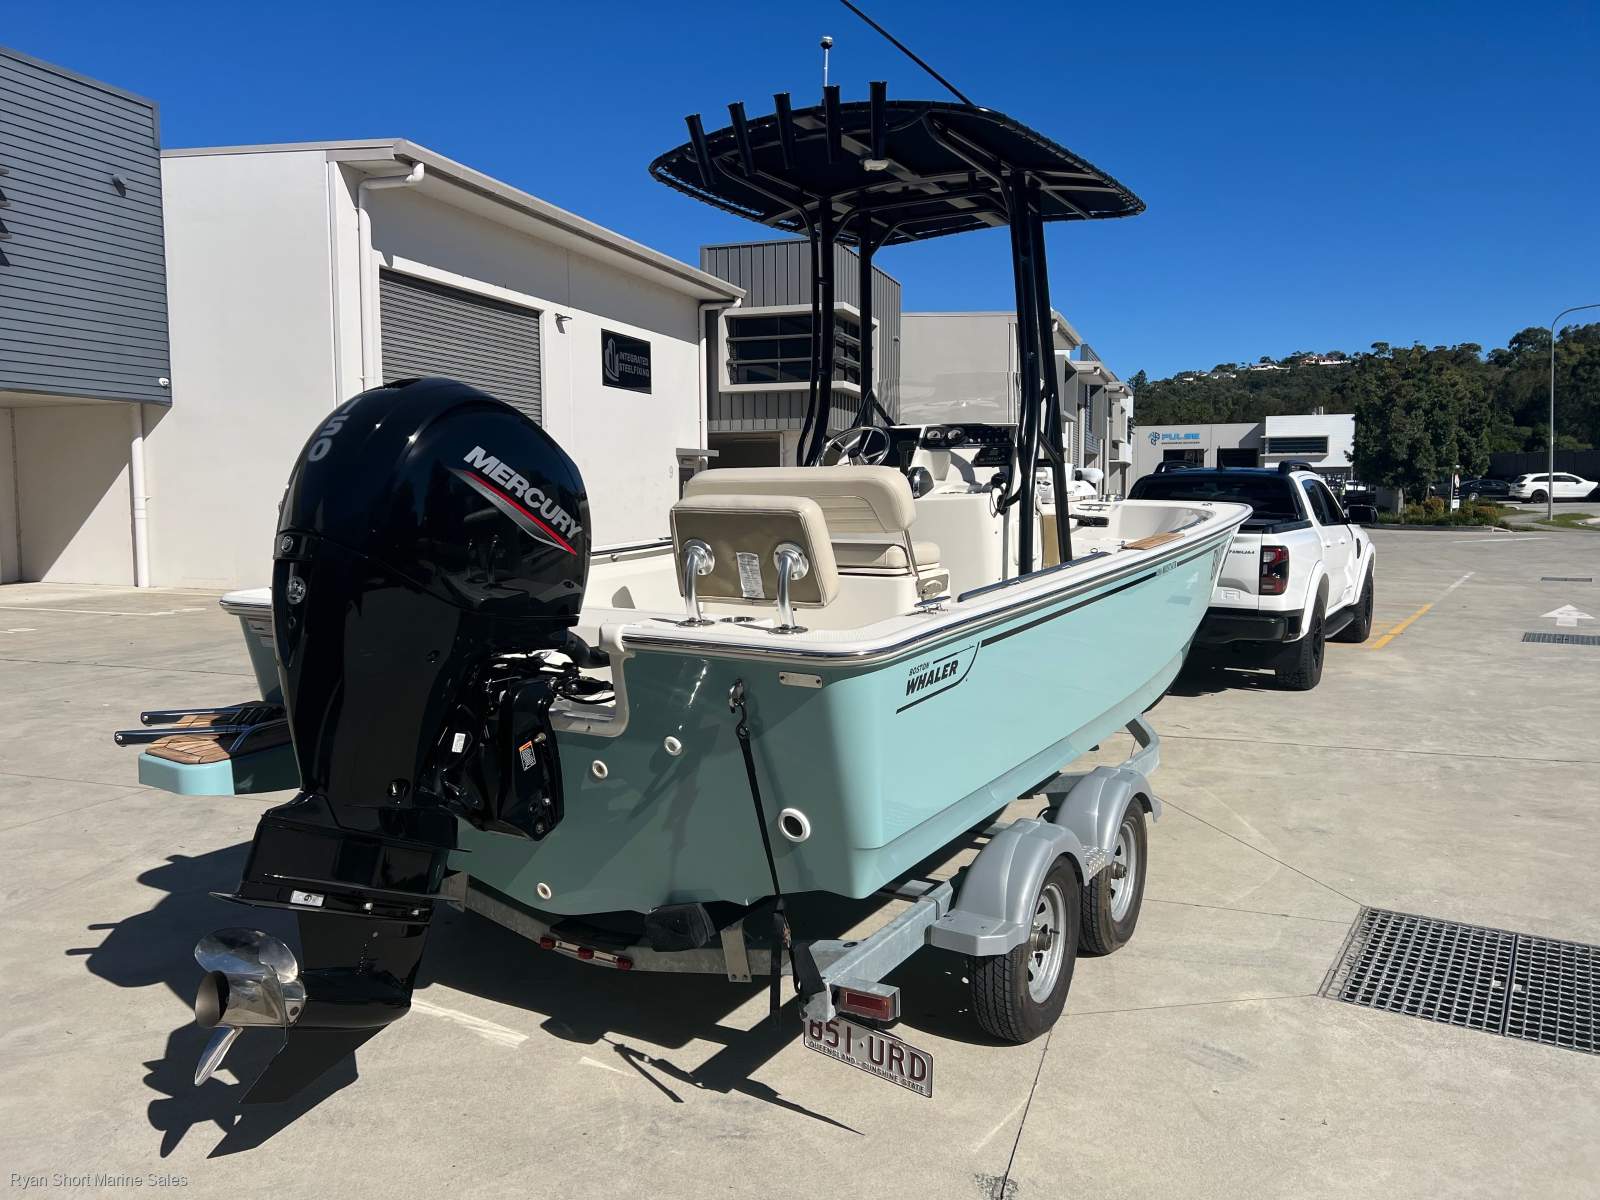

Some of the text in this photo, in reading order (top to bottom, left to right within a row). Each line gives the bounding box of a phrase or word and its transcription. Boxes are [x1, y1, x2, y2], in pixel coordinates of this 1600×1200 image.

[308, 397, 362, 462] 150
[1161, 432, 1200, 441] PULSE
[463, 445, 583, 539] MERCURY
[905, 660, 959, 696] WHALER
[908, 661, 930, 676] BOSTON
[808, 1040, 925, 1093] QUEENSLAND SUNSHINE STATE
